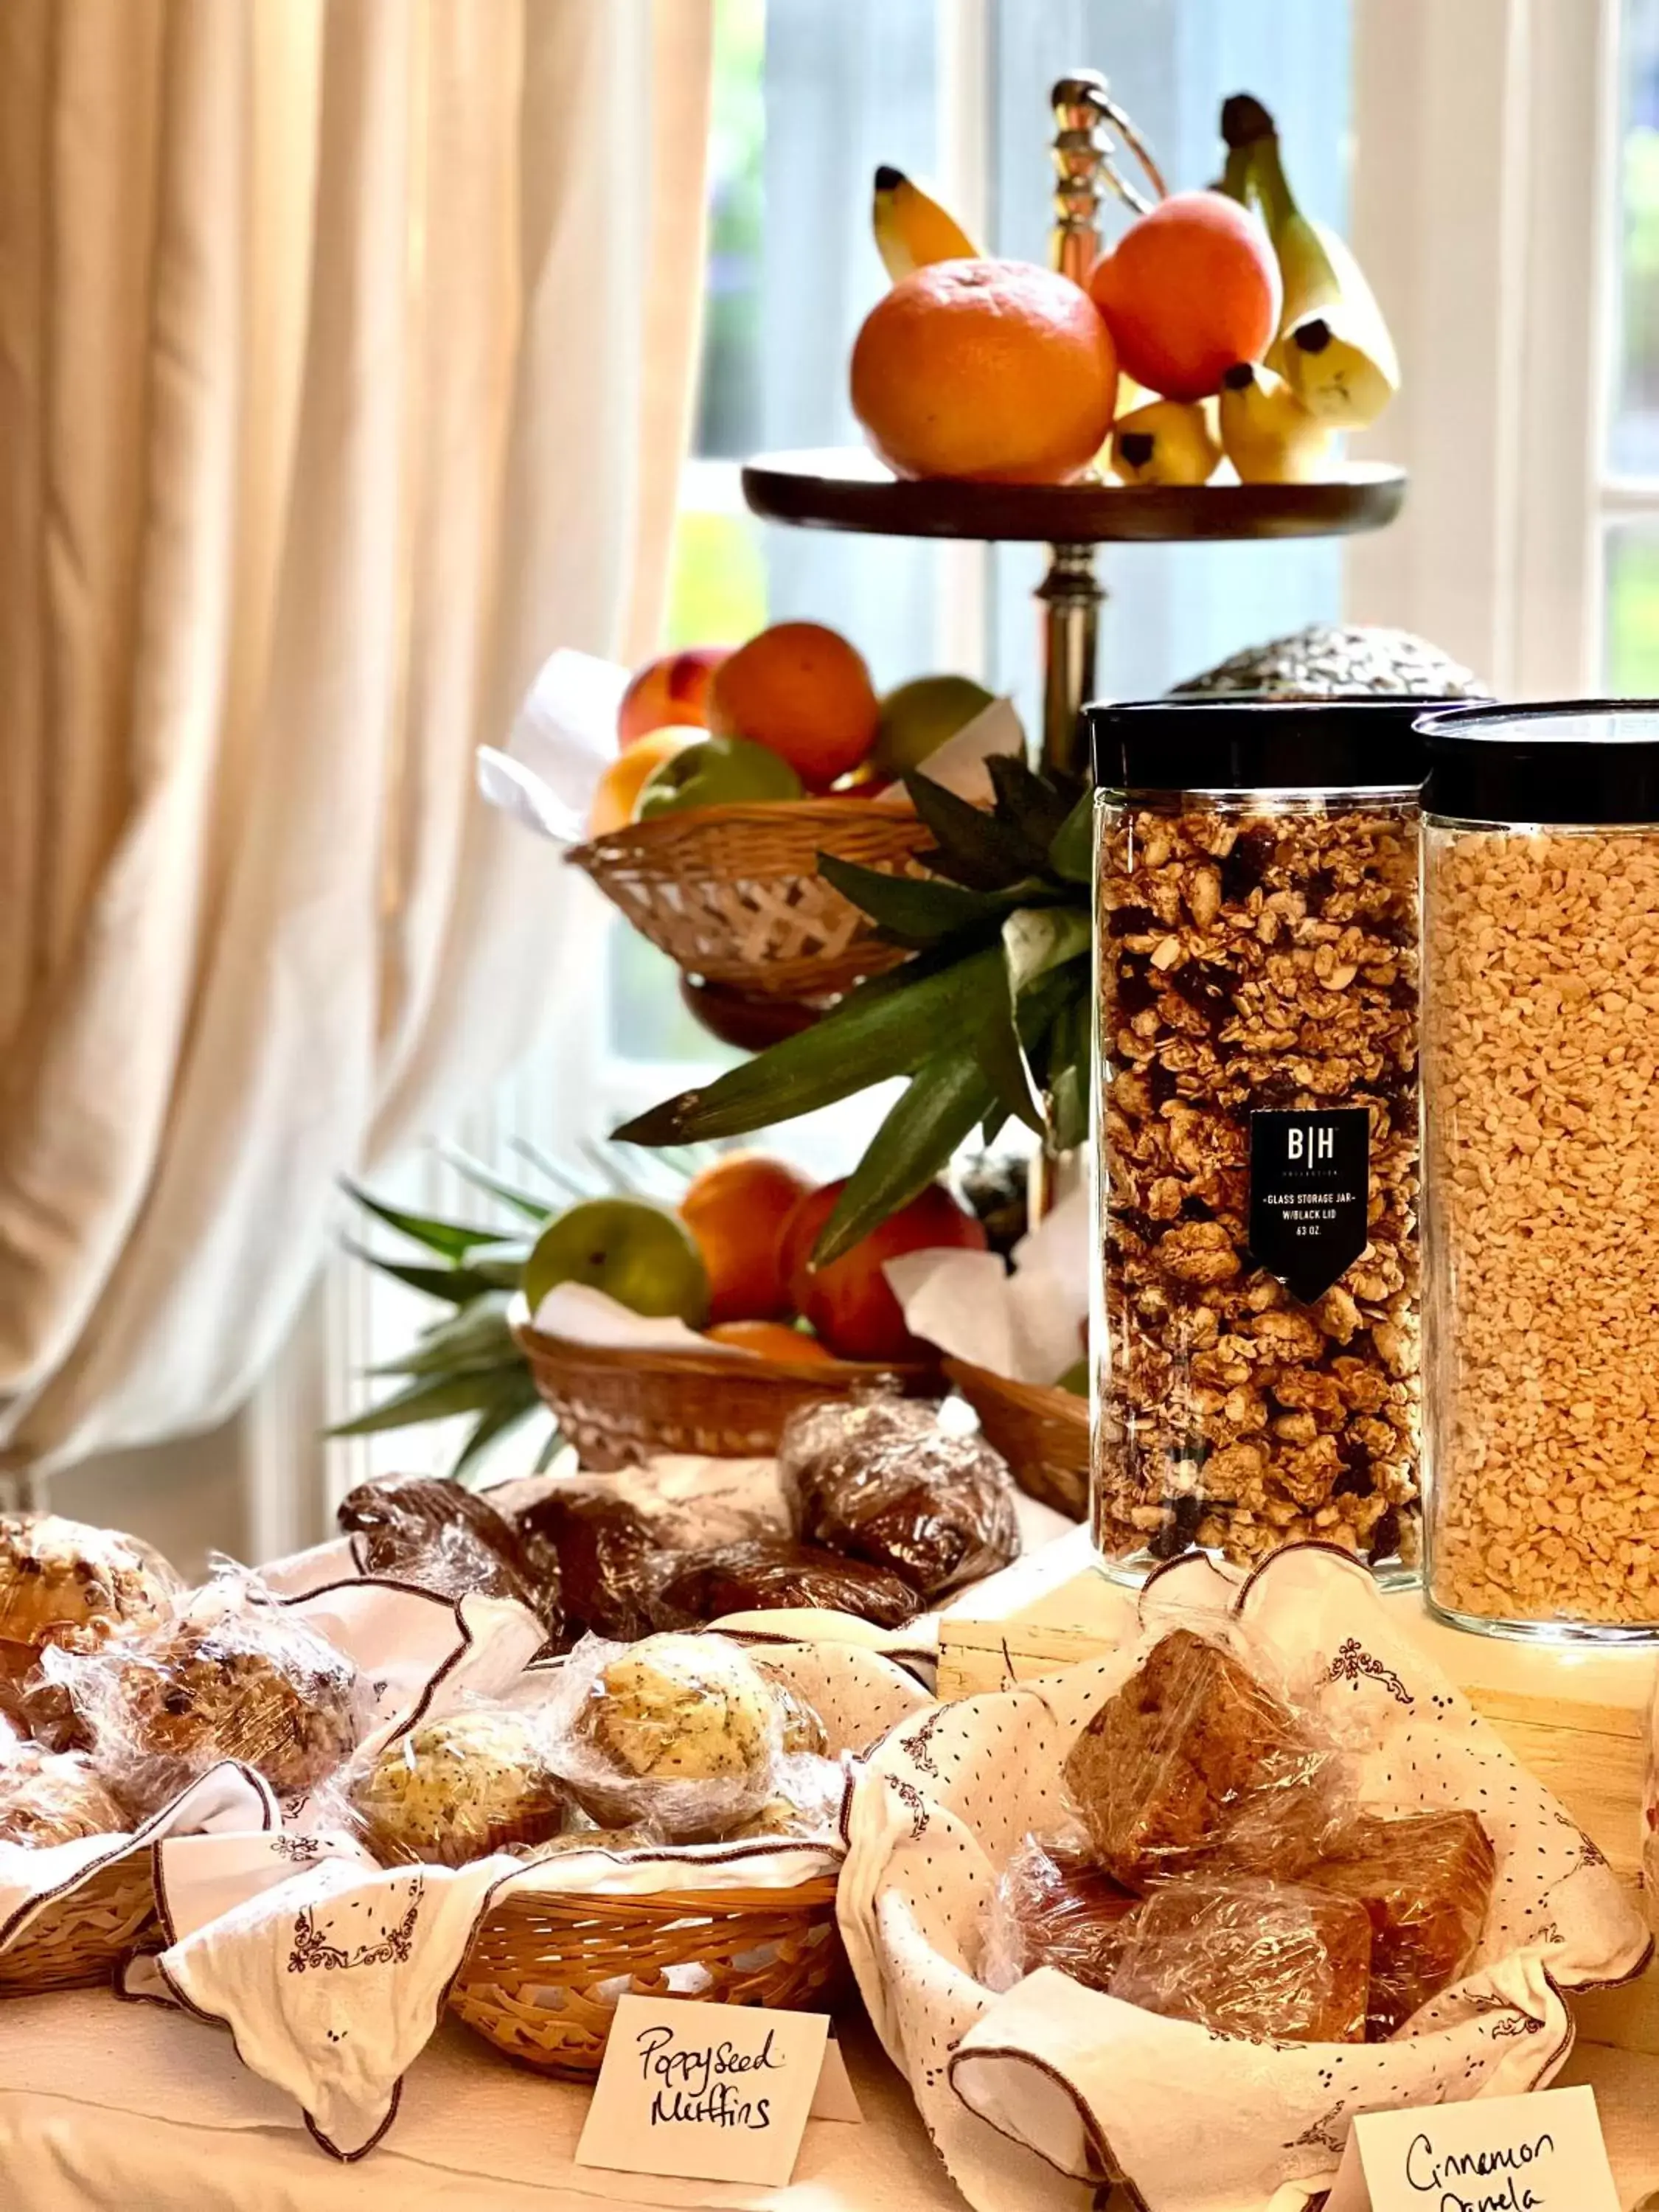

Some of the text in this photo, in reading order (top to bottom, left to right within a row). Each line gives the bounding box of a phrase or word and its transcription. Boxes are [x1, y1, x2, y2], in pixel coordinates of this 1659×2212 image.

[1297, 1193, 1334, 1204] STORAGE
[1282, 1208, 1337, 1220] W/BLACK LID
[1296, 1225, 1307, 1237] 63
[651, 2081, 771, 2129] Muffins
[1406, 2134, 1554, 2191] Cinnamon
